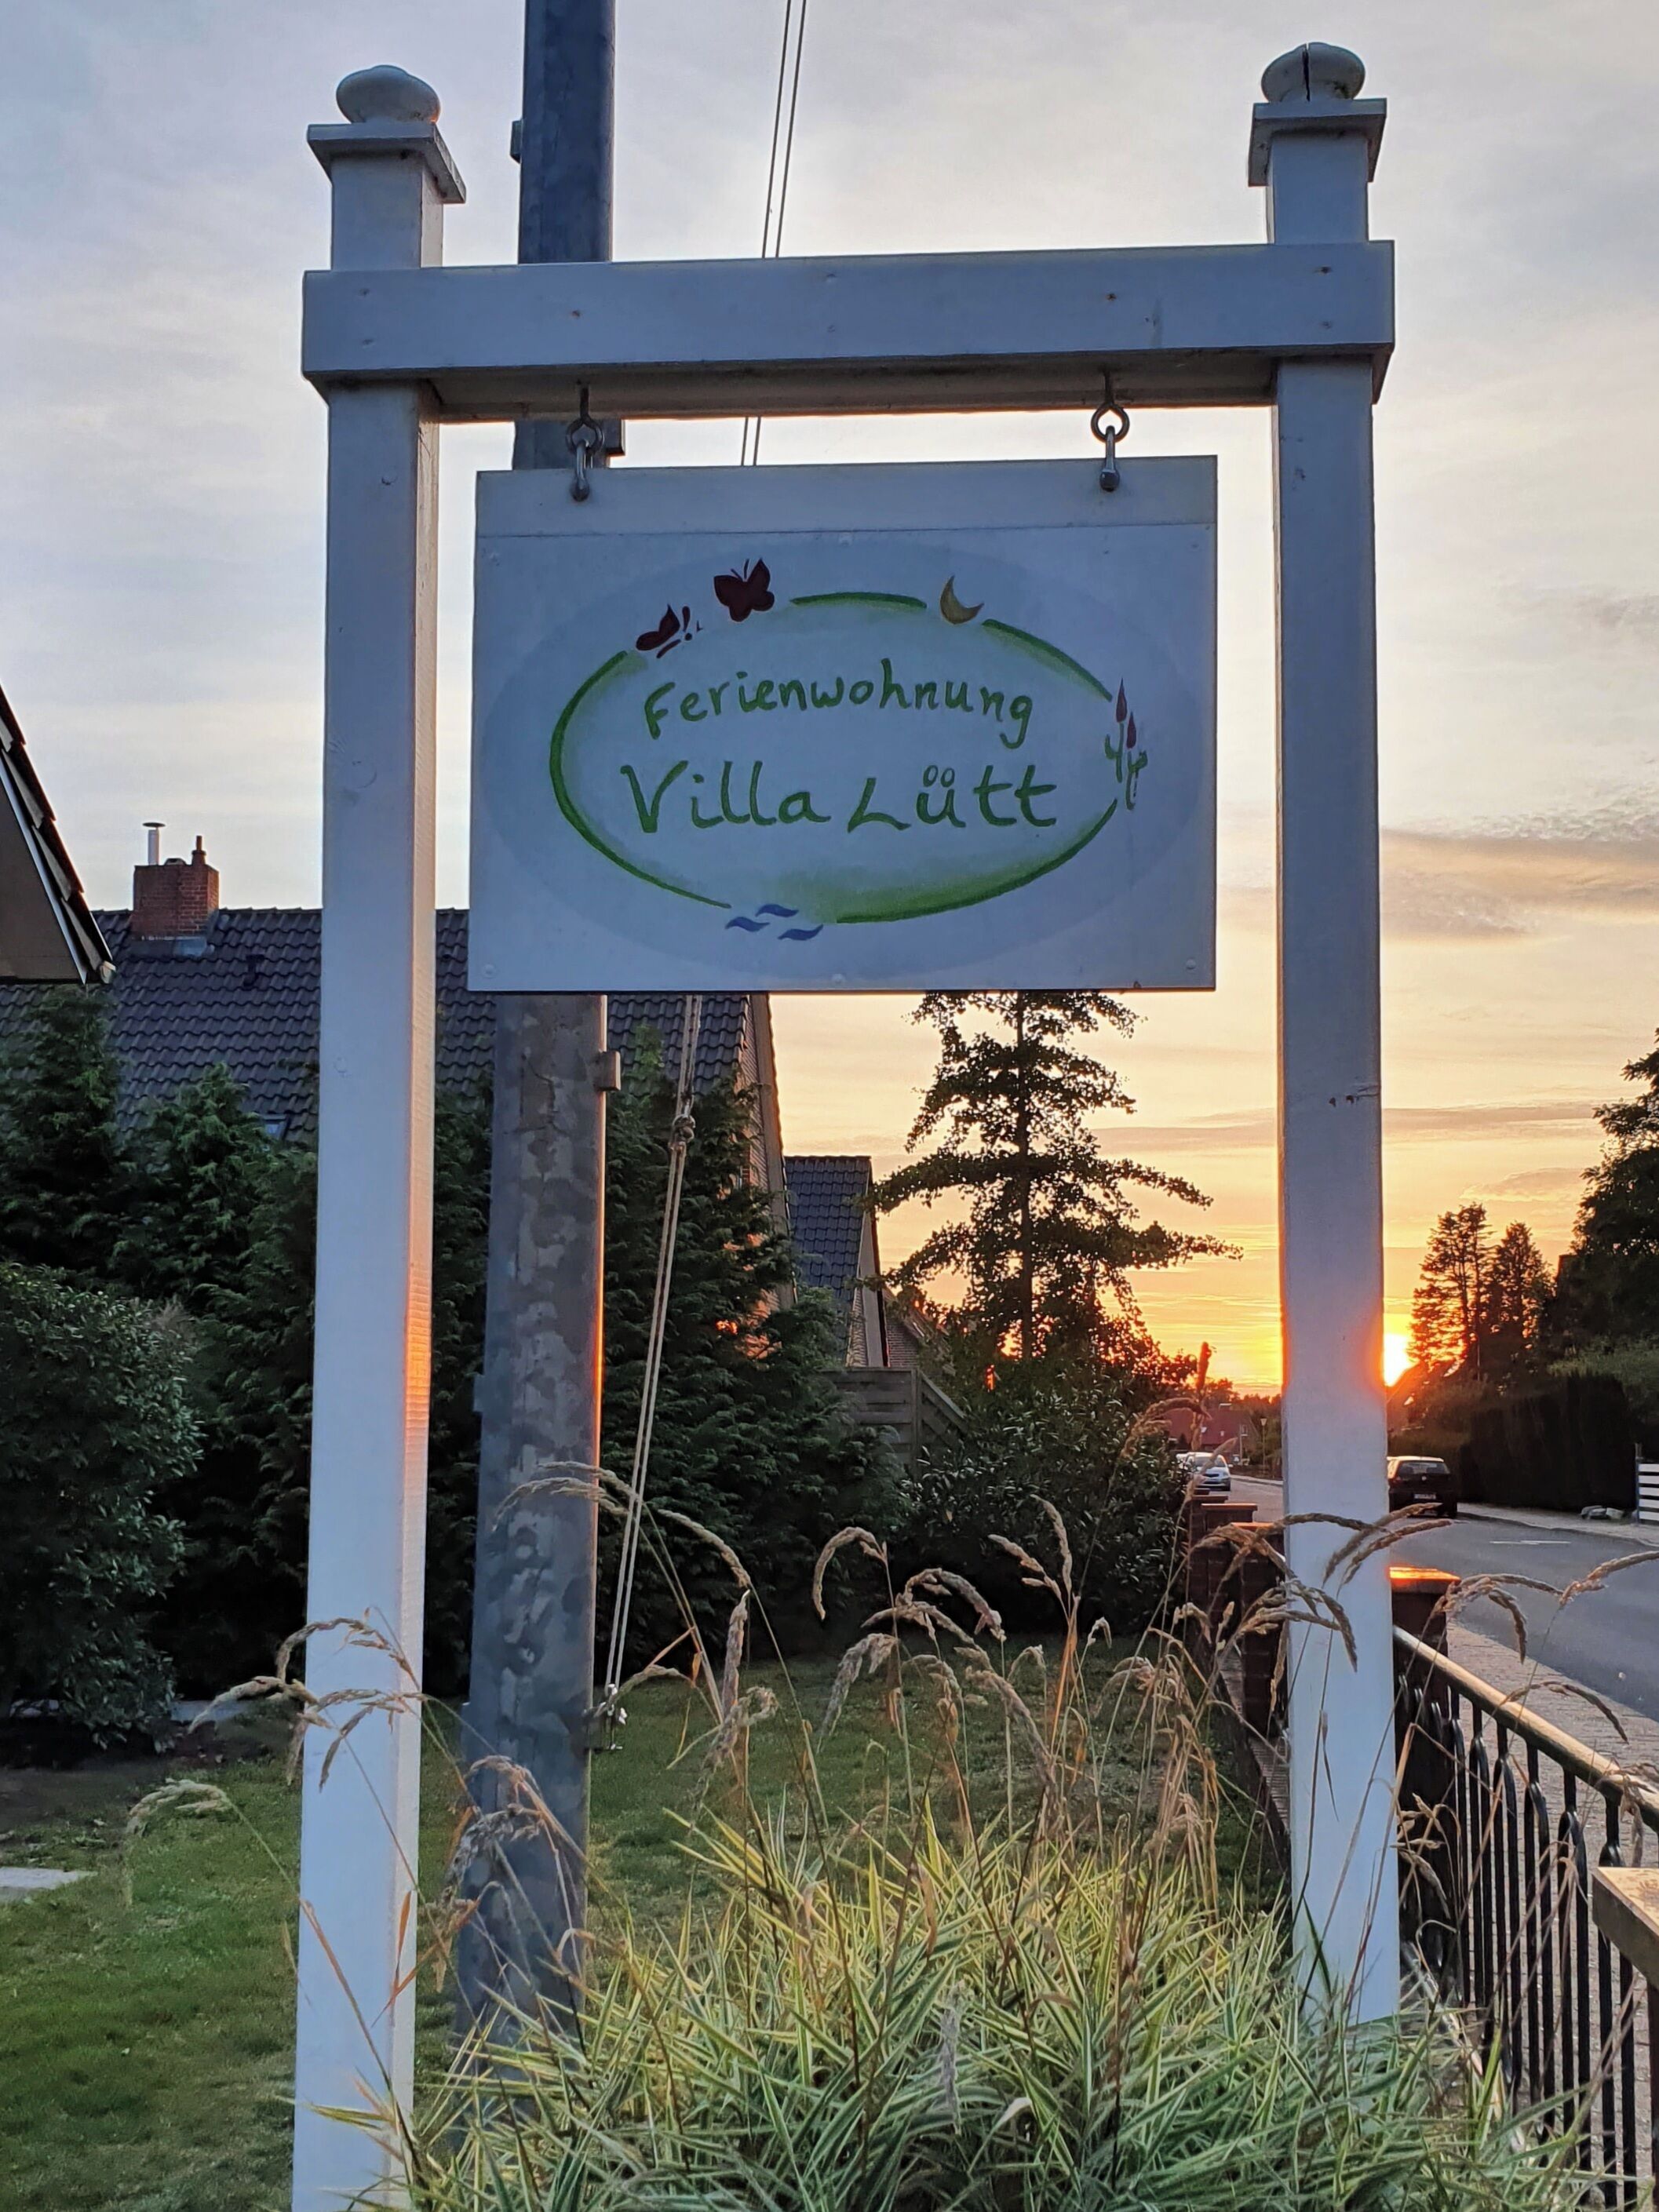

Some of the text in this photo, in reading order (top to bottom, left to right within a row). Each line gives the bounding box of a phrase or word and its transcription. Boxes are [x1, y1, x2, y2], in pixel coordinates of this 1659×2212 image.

[644, 658, 1034, 750] Ferienwohnung
[619, 760, 1057, 834] Villa Lütt
